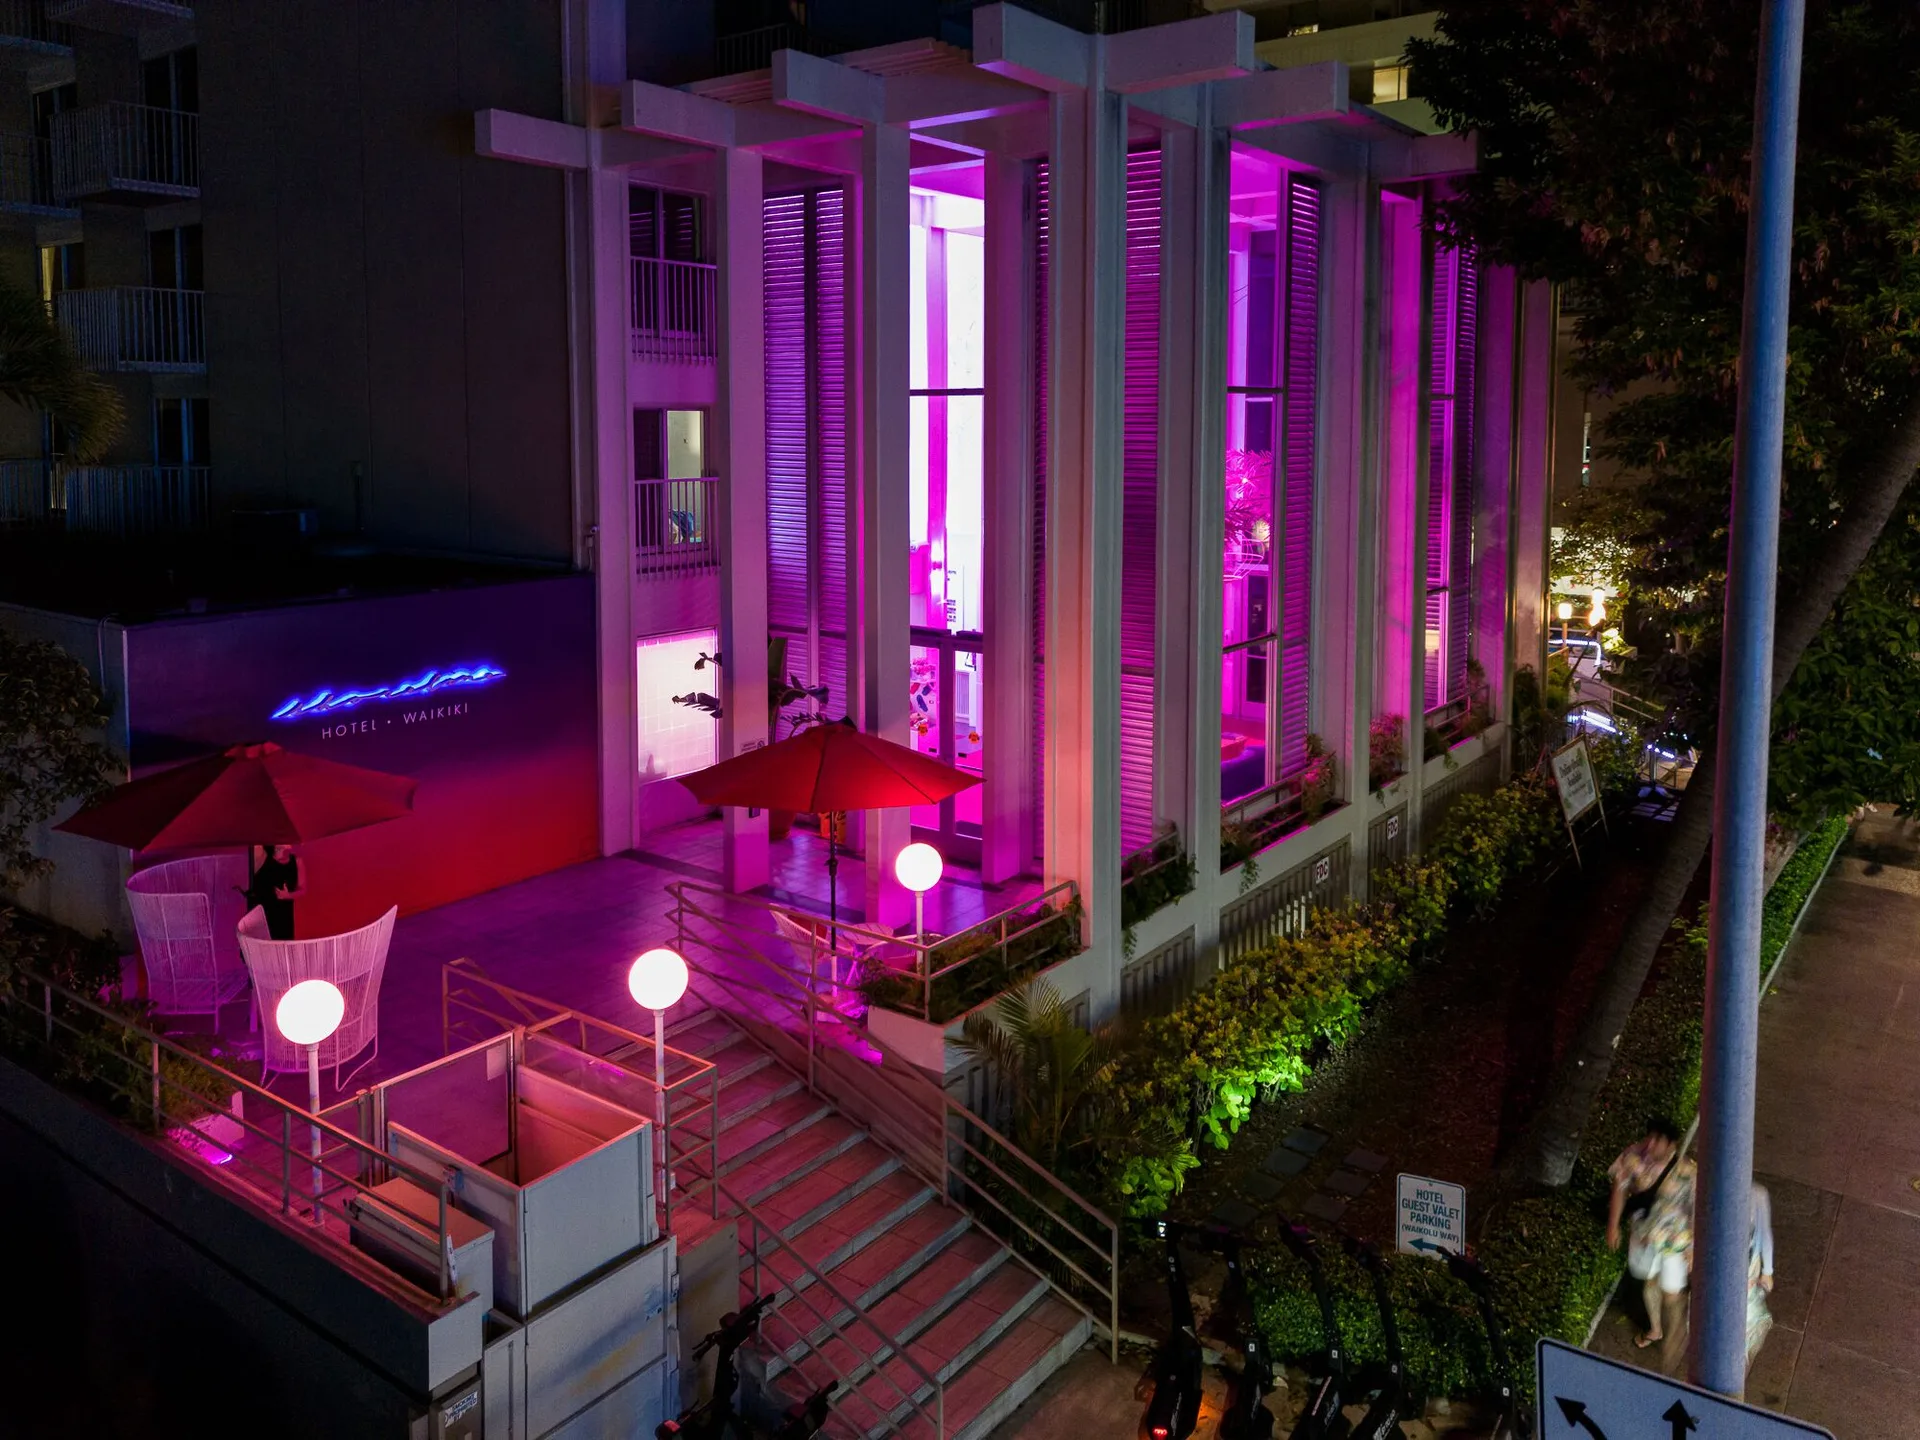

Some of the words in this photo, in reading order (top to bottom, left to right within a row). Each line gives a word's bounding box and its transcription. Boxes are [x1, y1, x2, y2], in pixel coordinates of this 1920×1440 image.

[321, 719, 377, 740] HOTEL
[402, 702, 469, 725] WAIKIKI
[1316, 860, 1328, 879] FDC
[1416, 1189, 1445, 1204] HOTEL
[1402, 1198, 1430, 1213] GUEST
[1432, 1203, 1460, 1220] VALET
[1410, 1212, 1451, 1230] PARKING
[1402, 1224, 1438, 1237] (WAIKOLU
[1440, 1231, 1460, 1244] WAY)
